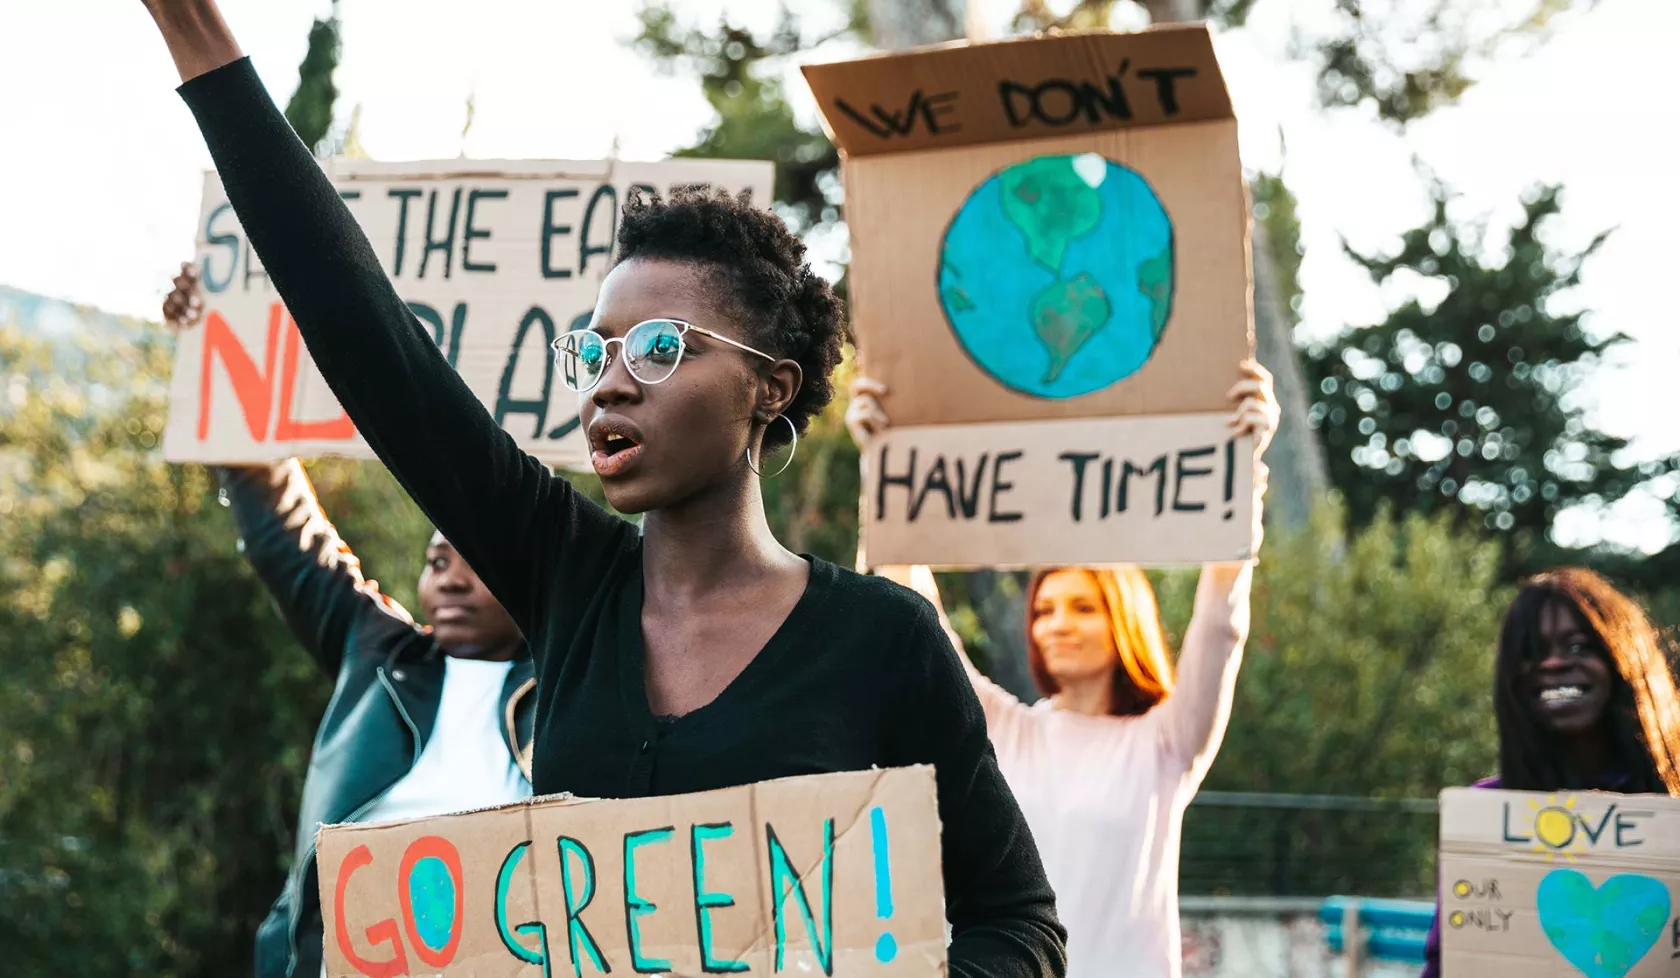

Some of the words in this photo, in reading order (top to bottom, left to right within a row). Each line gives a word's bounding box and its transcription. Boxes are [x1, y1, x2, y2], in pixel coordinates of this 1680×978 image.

[835, 89, 962, 138] WE
[997, 57, 1197, 129] DON'T
[388, 187, 508, 279] THE
[876, 445, 1025, 523] HAVE
[1058, 438, 1236, 521] TIME!
[1503, 801, 1656, 848] LOVE
[334, 835, 464, 978] GO
[494, 806, 898, 978] GREEN!
[1450, 907, 1513, 932] ONLY
[1453, 879, 1502, 900] OUR
